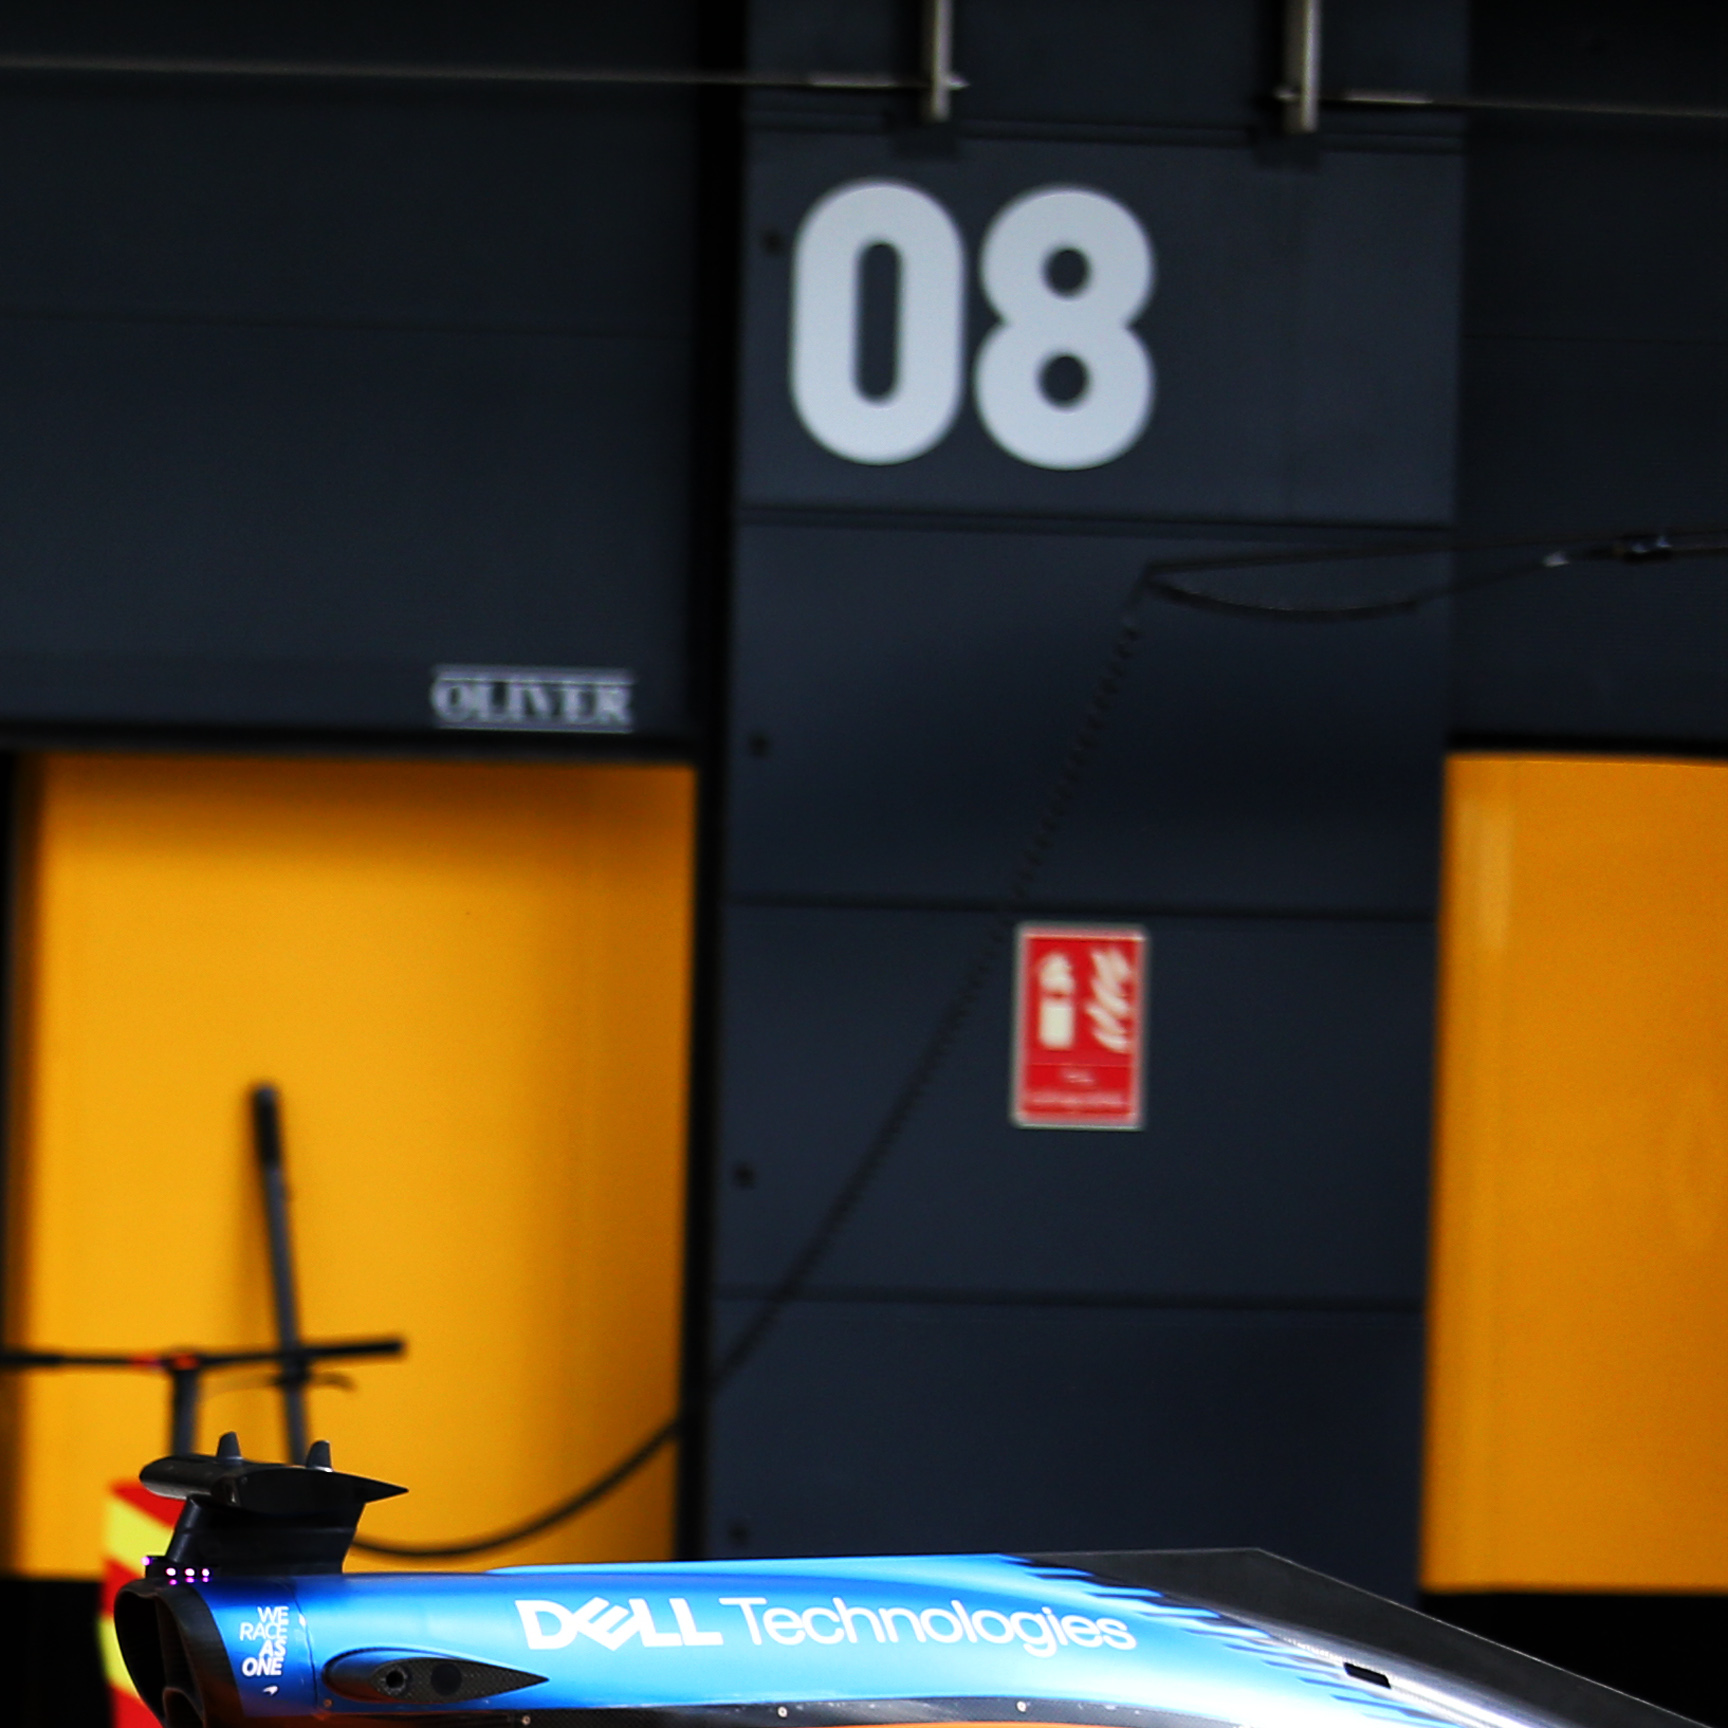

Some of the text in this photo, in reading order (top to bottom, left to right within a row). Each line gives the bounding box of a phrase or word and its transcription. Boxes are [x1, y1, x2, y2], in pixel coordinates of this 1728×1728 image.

[790, 180, 1155, 470] 08
[430, 674, 632, 729] OLIVER
[257, 1605, 290, 1625] WE
[239, 1621, 289, 1642] RACE
[514, 1596, 1137, 1658] DELL Technologies
[258, 1639, 287, 1658] AS
[242, 1656, 285, 1677] ONE
